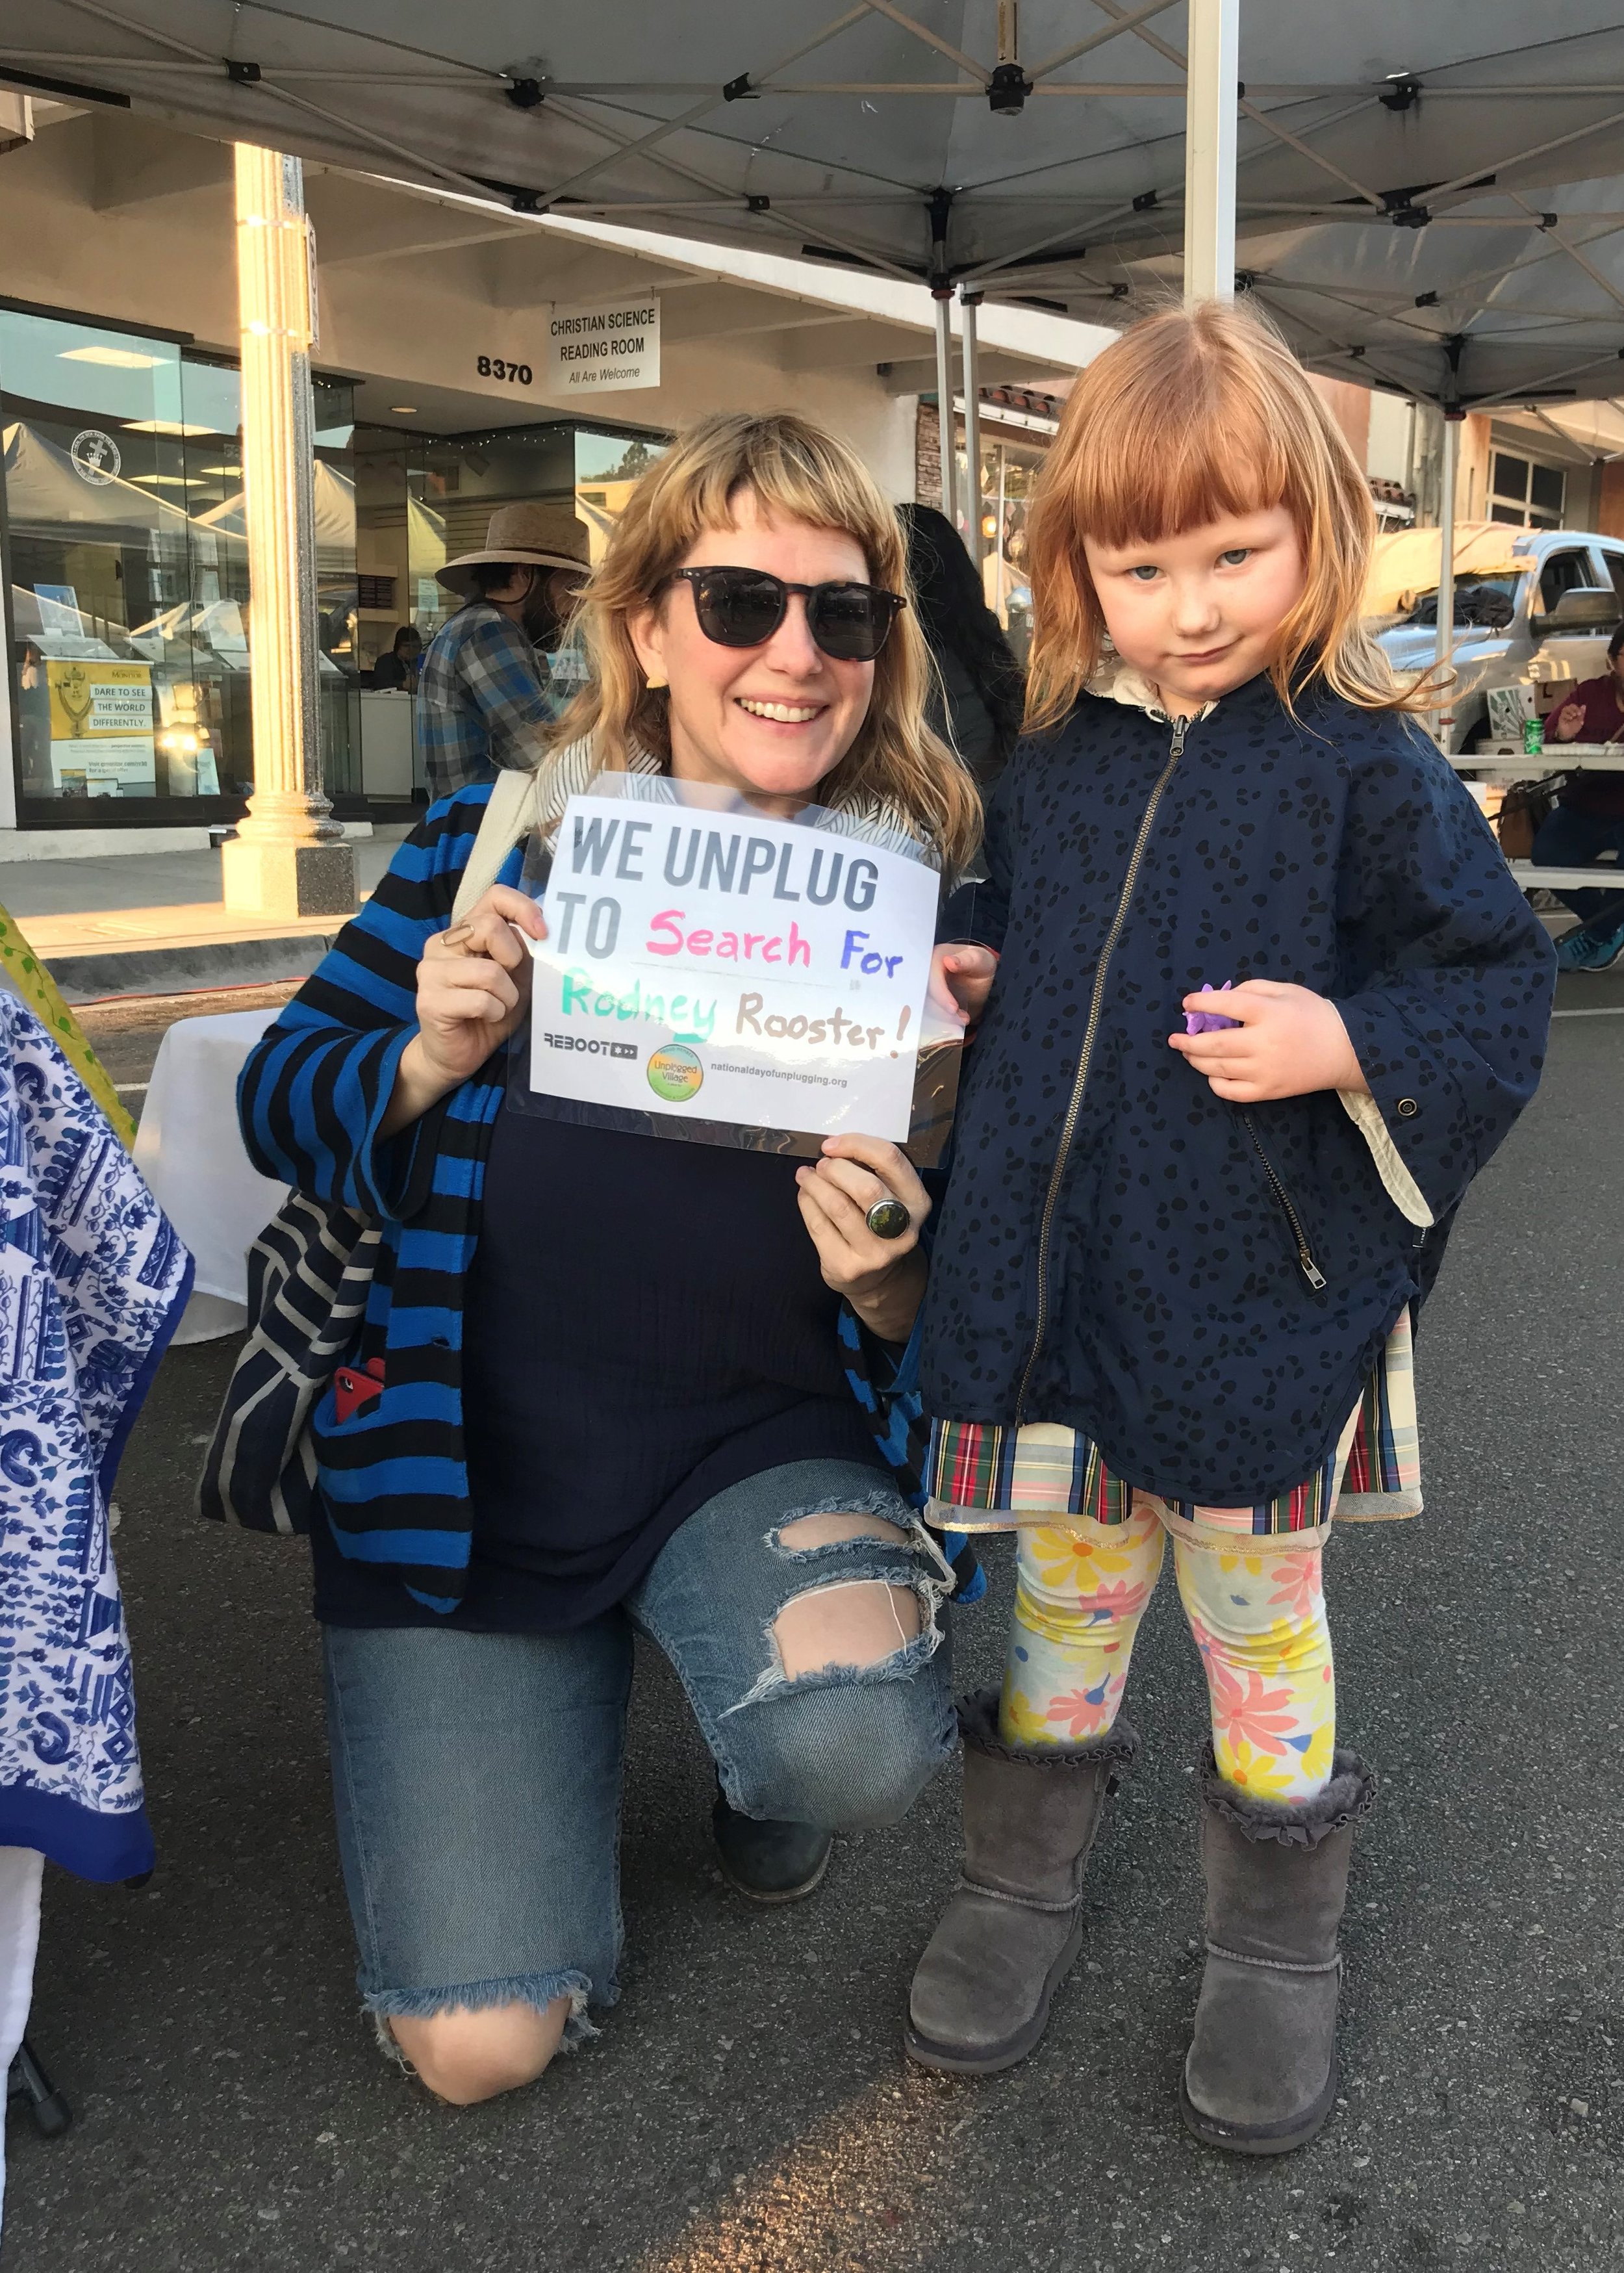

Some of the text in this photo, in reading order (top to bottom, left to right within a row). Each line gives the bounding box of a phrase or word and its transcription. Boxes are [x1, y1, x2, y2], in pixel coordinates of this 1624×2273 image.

[550, 309, 655, 336] CHRISTIAN SCIENCE
[561, 337, 644, 361] READING ROOM
[477, 355, 533, 385] 8370
[569, 368, 640, 384] All Are Welcome
[95, 687, 116, 696] DARE
[93, 719, 146, 727] DIFFERENTLY.
[572, 815, 879, 912] WE UNPLUG
[556, 892, 622, 960] TO
[646, 910, 903, 979] Search For
[561, 967, 718, 1044] Rodney
[544, 1033, 611, 1056] REBOOT
[662, 1072, 689, 1083] Village
[710, 1062, 848, 1088] nationaldayofunplugging.org
